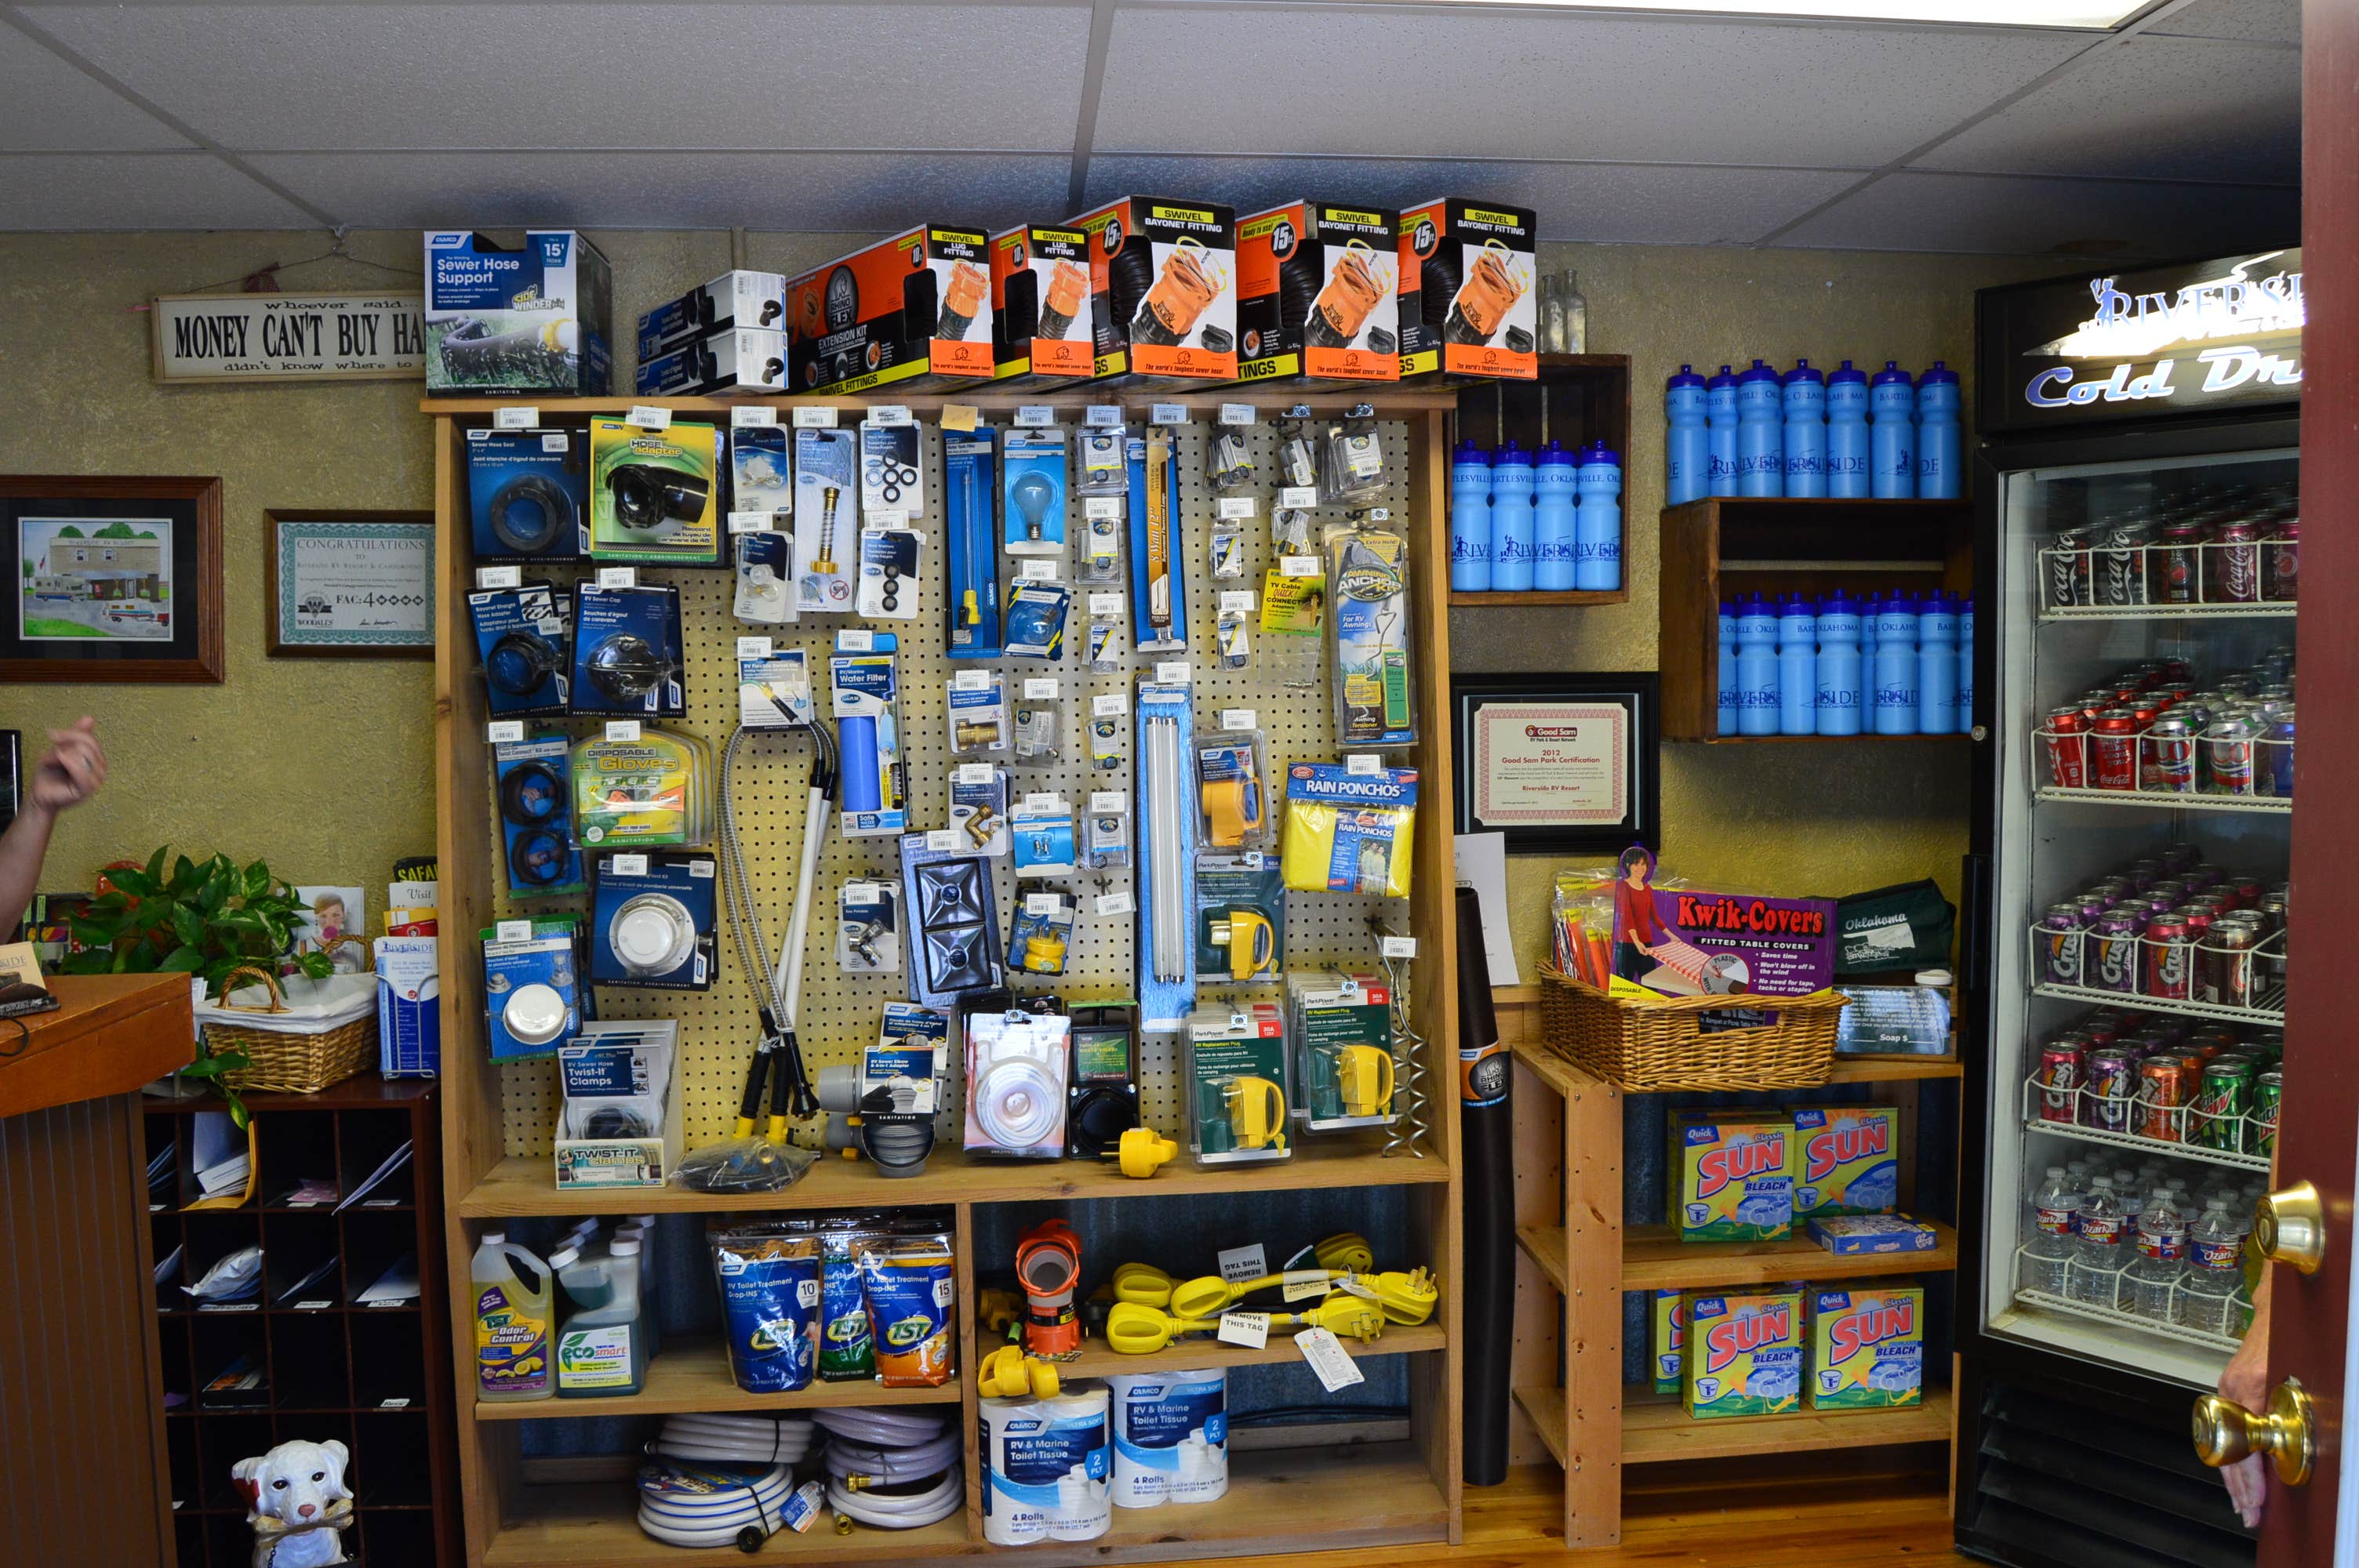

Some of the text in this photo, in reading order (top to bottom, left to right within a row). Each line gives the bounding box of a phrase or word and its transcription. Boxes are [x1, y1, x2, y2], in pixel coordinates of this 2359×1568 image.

[1165, 210, 1204, 220] SWIVEL
[1336, 212, 1372, 223] SWIVEL
[1475, 212, 1509, 223] SWIVEL
[1146, 218, 1222, 232] BAYONET FITTING
[1318, 221, 1388, 235] BAYONET FITTING
[1458, 220, 1525, 235] BAYONET FITTING
[941, 234, 975, 243] SWIVEL
[1041, 233, 1076, 242] SWIVEL
[544, 243, 564, 256] 15'
[944, 249, 974, 257] FITTING
[1045, 247, 1074, 256] FITTING
[438, 259, 519, 270] Sewer Hose
[438, 272, 493, 285] Support
[514, 291, 536, 302] SIDE
[264, 300, 348, 310] whoever
[513, 299, 551, 311] WINDER
[831, 297, 850, 310] RHINO
[174, 315, 249, 358] MONEY
[263, 312, 324, 358] CAN'T
[338, 314, 380, 357] BUY
[819, 325, 867, 350] EXTENSION KIT
[224, 361, 271, 371] didn't
[282, 361, 324, 370] know
[336, 361, 386, 370] where
[845, 374, 878, 391] FITTINGS
[2026, 359, 2174, 407] Cold
[631, 440, 663, 448] HOSE
[634, 446, 681, 456] adapter
[297, 539, 425, 550] CONGRATULATIONS
[1339, 578, 1401, 592] ANCHOR
[840, 674, 865, 683] Water
[598, 757, 678, 771] Gloves
[1306, 780, 1401, 797] RAIN PONCHOS
[1339, 824, 1393, 837] RAIN PONCHOS
[408, 888, 431, 899] Visit
[1677, 895, 1824, 935] Kwik-Covers
[1845, 912, 1907, 931] Oklahoma
[1701, 938, 1736, 947] FITTED
[1740, 940, 1770, 949] TABLE
[1714, 955, 1738, 964] PLASTIC
[570, 1076, 612, 1087] Clamps
[1797, 1112, 1820, 1123] Quick
[1859, 1115, 1888, 1125] Classic
[1688, 1128, 1712, 1139] Quick
[1755, 1131, 1783, 1142] Classic
[575, 1149, 637, 1159] TWIST-IT
[1805, 1123, 1889, 1184] SUN
[589, 1156, 644, 1167] clamps
[1697, 1140, 1784, 1200] SUN
[1744, 1181, 1787, 1192] BLEACH
[1241, 1259, 1262, 1269] THIS
[801, 1282, 815, 1295] 10
[938, 1283, 951, 1296] 15
[1820, 1294, 1843, 1305] Quick
[1885, 1296, 1913, 1307] Classic
[1697, 1301, 1720, 1312] Quick
[1761, 1302, 1790, 1312] Classic
[1228, 1312, 1263, 1321] REMOVE
[1226, 1319, 1245, 1329] THIS
[890, 1322, 931, 1339] TST
[1829, 1305, 1914, 1367] SUN
[491, 1333, 534, 1343] Control
[1707, 1310, 1790, 1374] SUN
[562, 1347, 594, 1359] eco
[1875, 1345, 1916, 1356] BLEACH
[1753, 1352, 1793, 1363] BLEACH
[1204, 1383, 1221, 1392] SOFT
[1157, 1404, 1189, 1413] Marine
[1009, 1417, 1103, 1430] CAMCO ULTRA SOFT
[1133, 1414, 1187, 1425] Toilet Tissue
[1212, 1419, 1219, 1430] 2
[1209, 1431, 1221, 1439] PLY
[1035, 1439, 1069, 1448] Marine
[1011, 1450, 1068, 1461] Toilet Tissue
[1093, 1455, 1101, 1466] 2
[1091, 1466, 1103, 1475] PLY
[1142, 1475, 1165, 1484] Rolls
